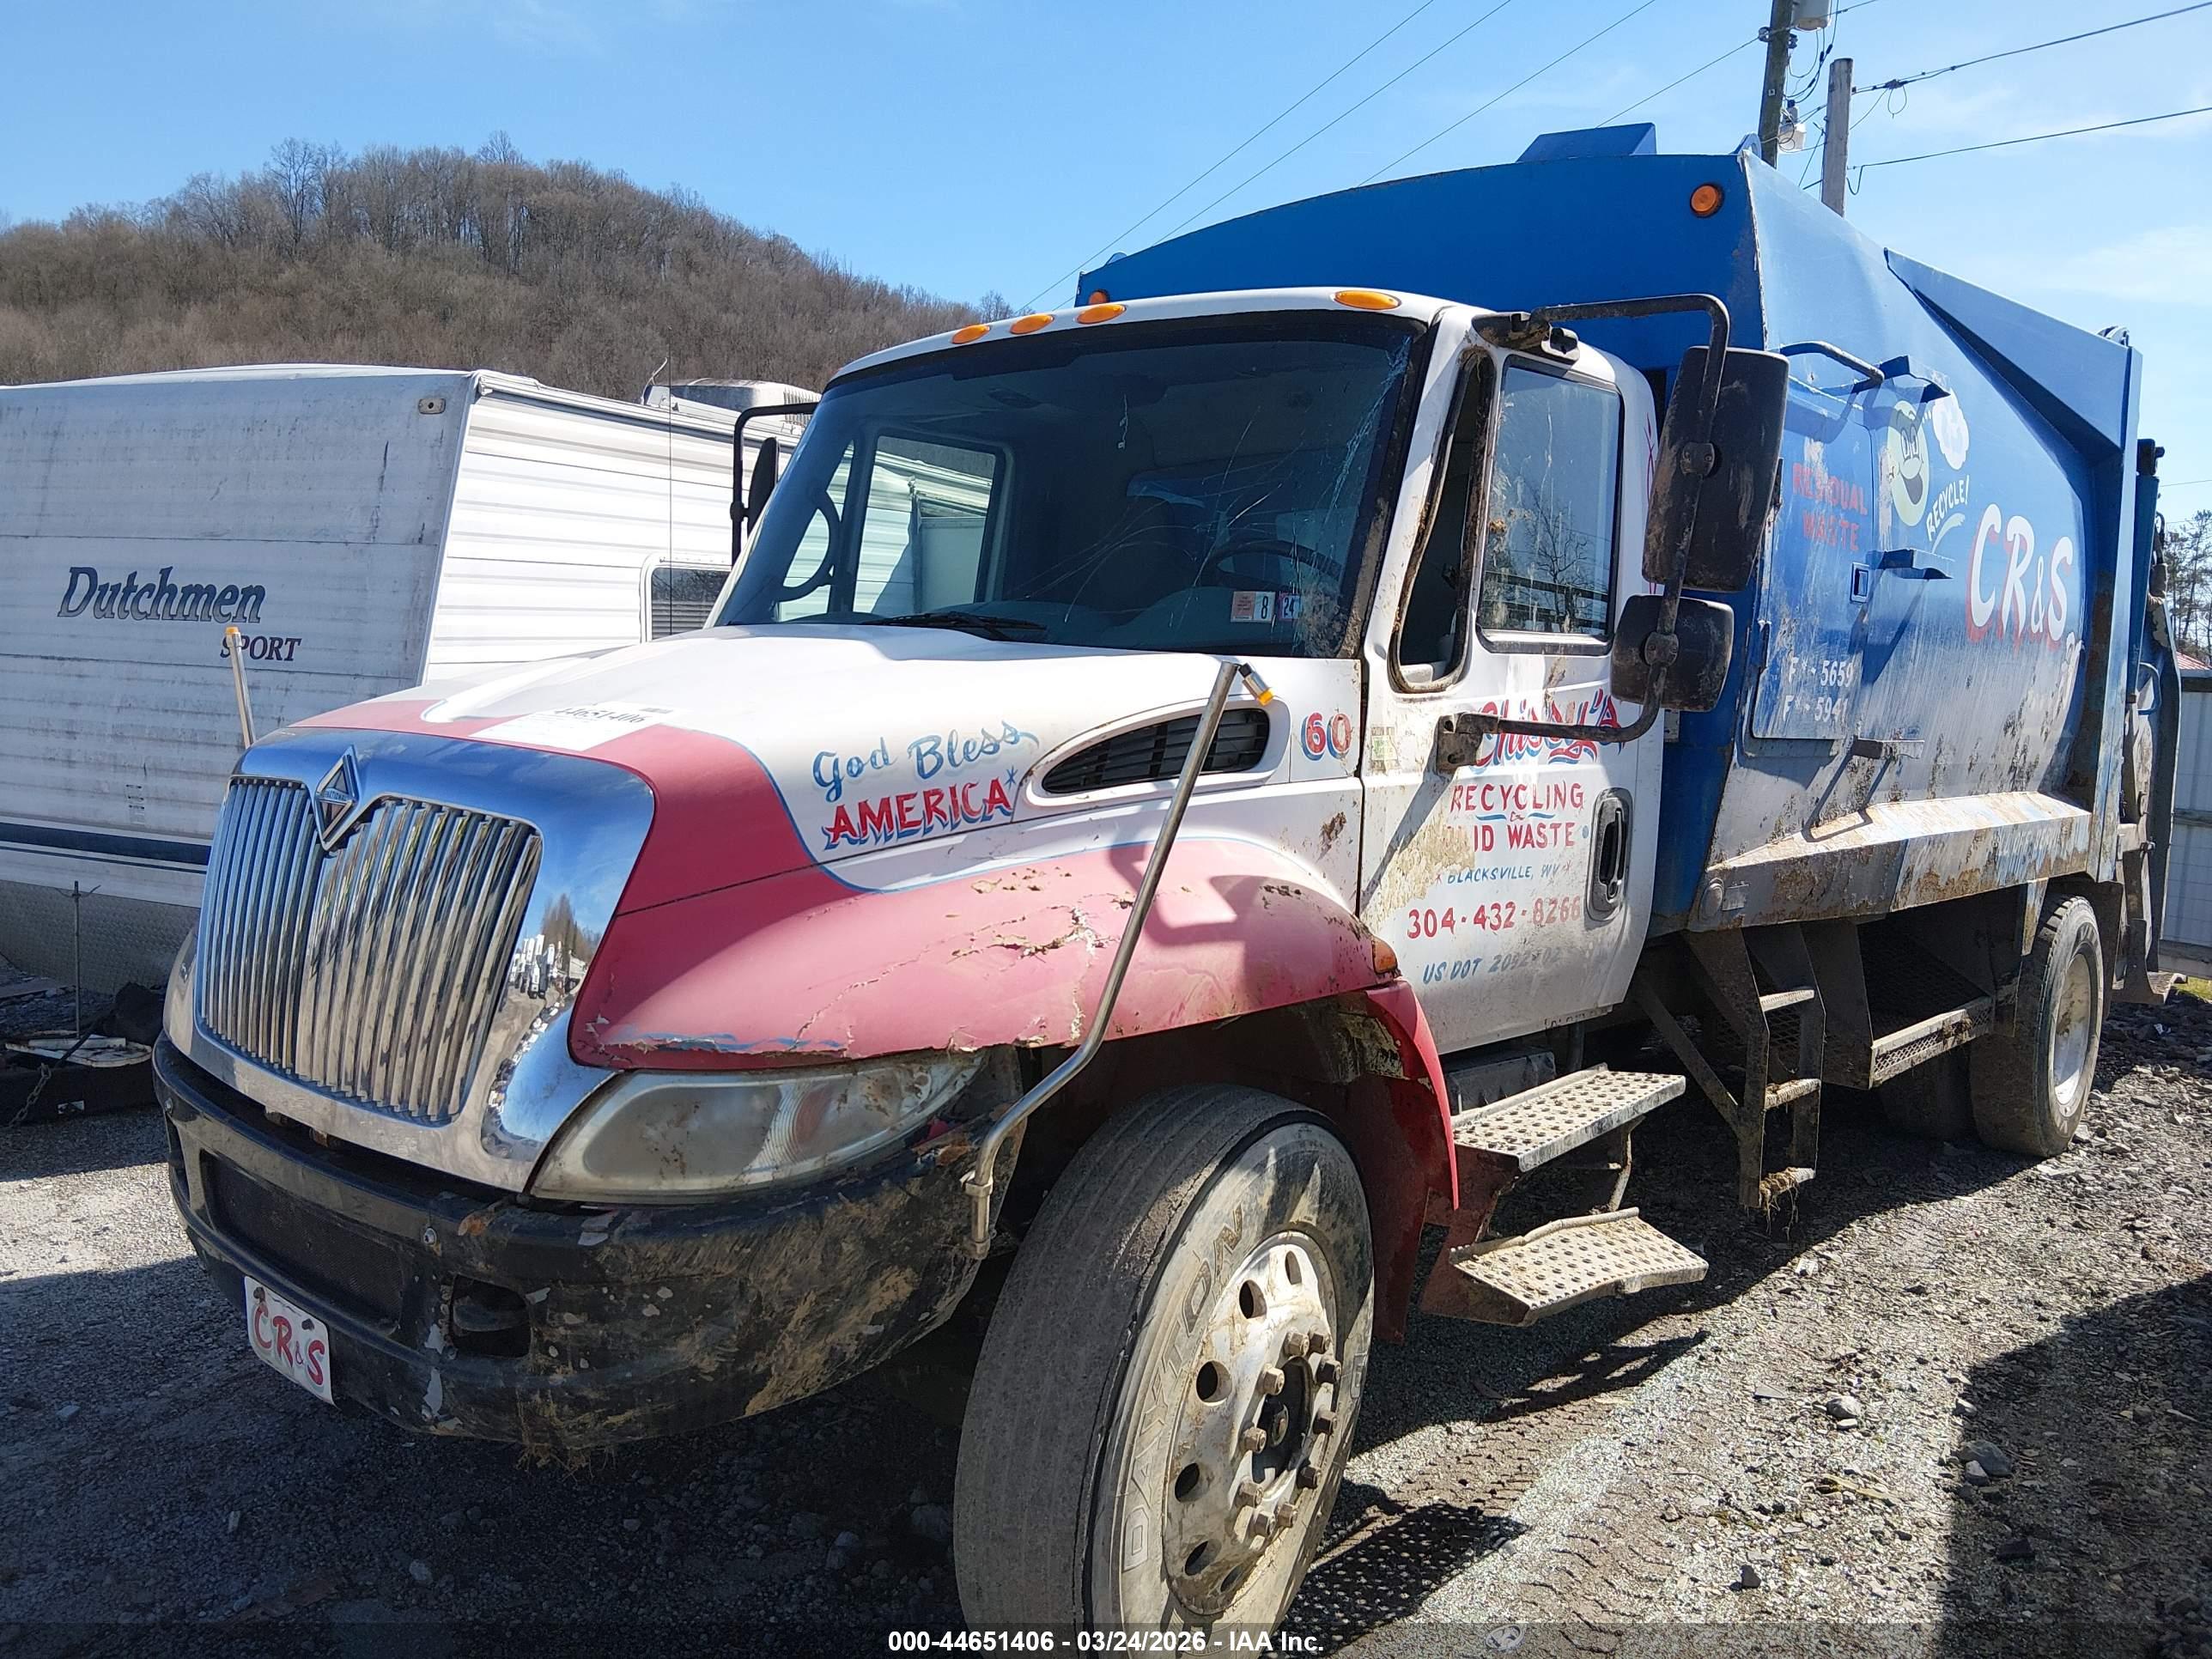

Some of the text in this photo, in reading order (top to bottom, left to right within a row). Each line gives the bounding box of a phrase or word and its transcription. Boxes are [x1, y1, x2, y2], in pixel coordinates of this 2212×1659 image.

[1926, 474, 1970, 542] RECYCLE!
[1802, 509, 1859, 550] WASTE
[57, 566, 266, 624] Dutchmen
[1966, 503, 2073, 651] CR&S
[1261, 595, 1269, 619] 8
[220, 635, 301, 661] SPORT
[1820, 659, 1853, 687] 5659
[1814, 696, 1848, 723] 5941
[1302, 713, 1352, 760] 60
[812, 720, 1040, 802] God Bless
[822, 777, 1012, 850] AMERICA
[1449, 781, 1584, 812] RECYCLING
[1507, 822, 1576, 850] WASTE
[1540, 864, 1559, 878] WV
[1422, 961, 1447, 985] US
[1449, 957, 1484, 981] DOT
[253, 1304, 325, 1386] CR&S
